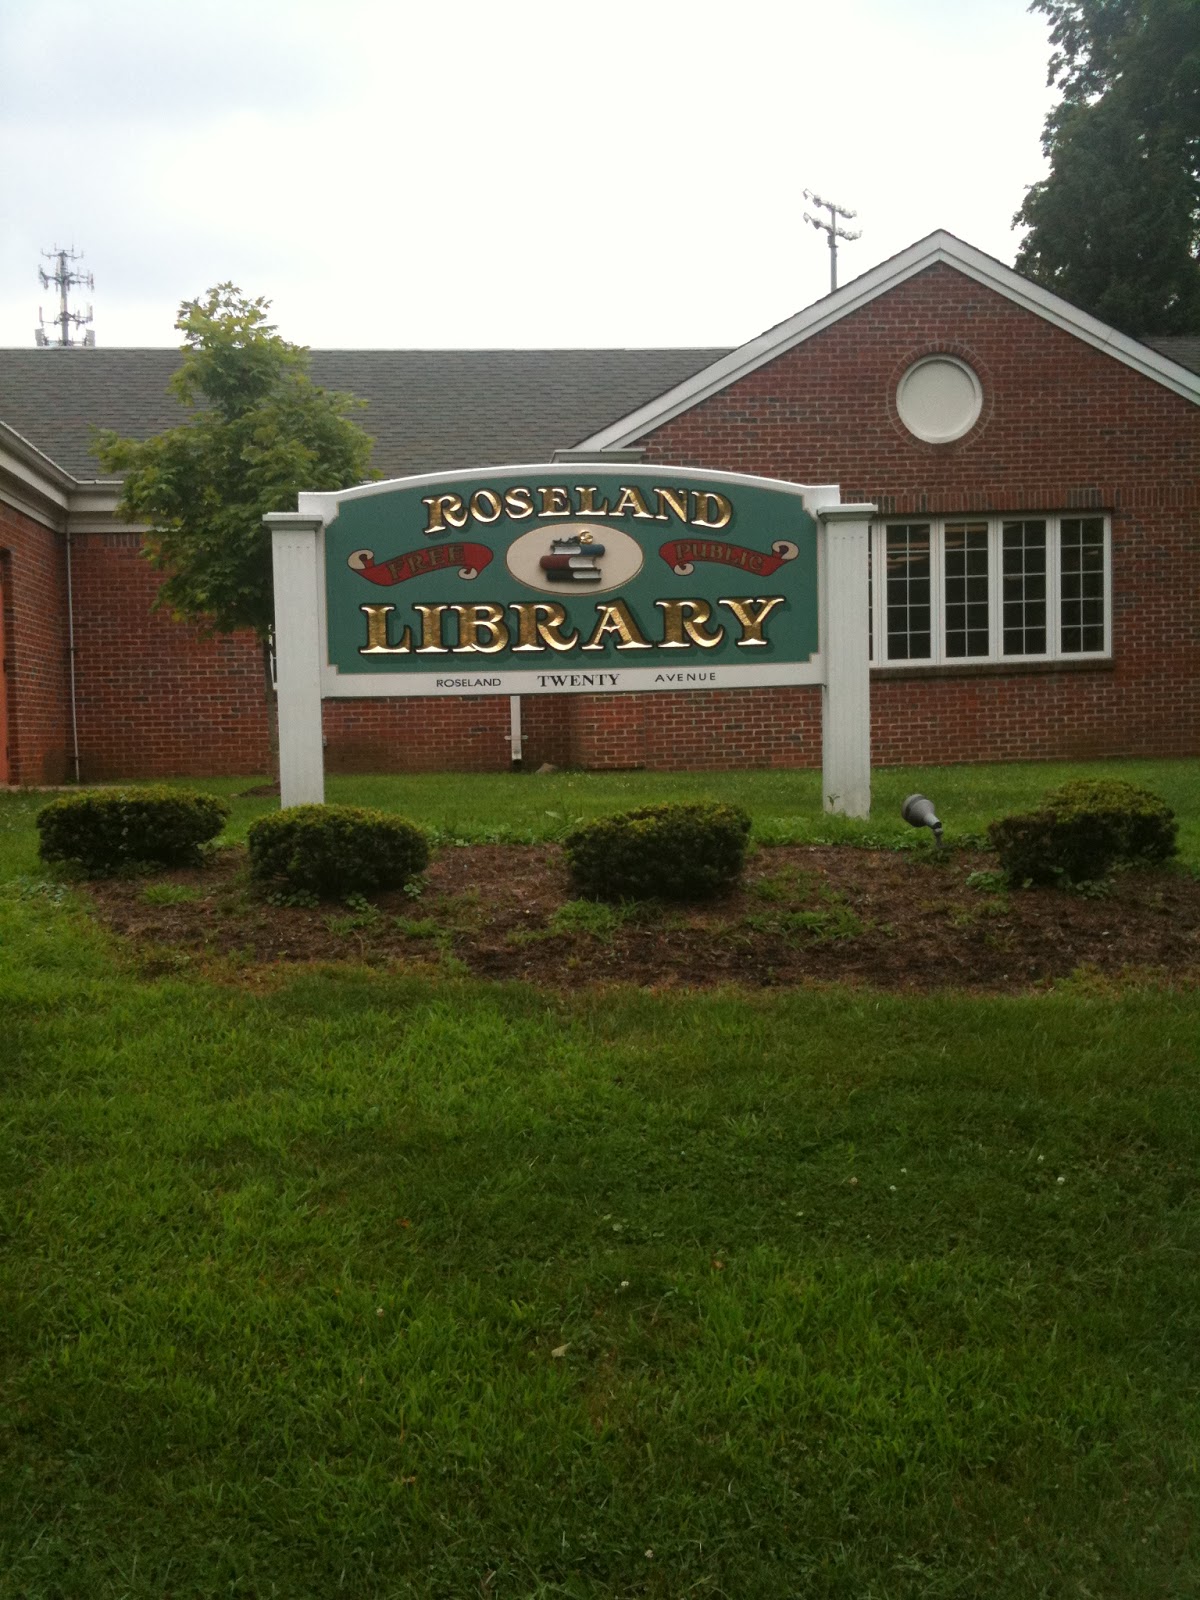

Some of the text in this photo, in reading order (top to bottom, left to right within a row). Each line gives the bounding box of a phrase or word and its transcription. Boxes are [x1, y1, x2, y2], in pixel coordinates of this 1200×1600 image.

[422, 484, 733, 534] ROSELAND
[387, 543, 466, 581] FREE
[674, 542, 764, 571] PUBLIC
[358, 596, 786, 656] LIBRARY
[435, 672, 717, 688] ROSELAND TWENTY AVENUE
